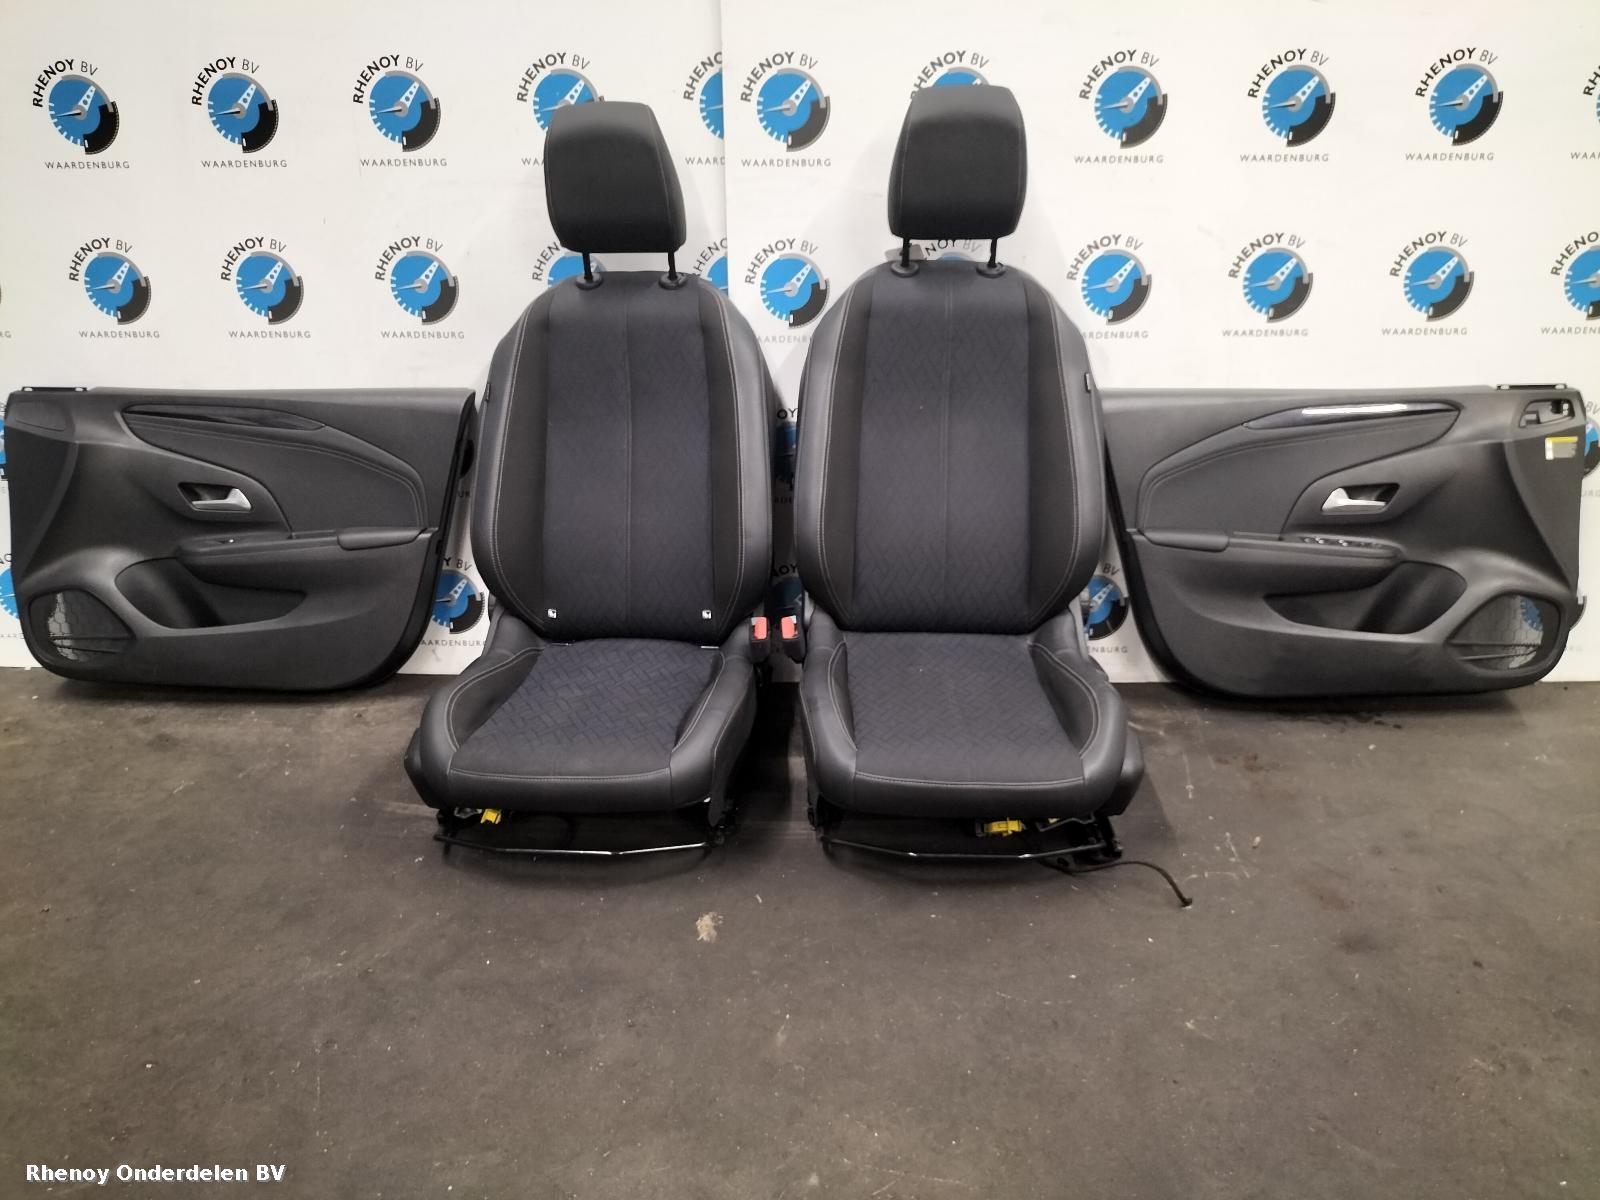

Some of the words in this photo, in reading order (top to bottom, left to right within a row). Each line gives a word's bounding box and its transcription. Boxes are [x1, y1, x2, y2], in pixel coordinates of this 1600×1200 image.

[353, 54, 400, 104] RHENOY
[405, 56, 424, 72] BV
[516, 52, 567, 103] RHENOY
[571, 54, 591, 71] BV
[683, 51, 722, 101] RHENO
[740, 51, 795, 102] RHENOY
[799, 53, 819, 70] BV
[970, 52, 990, 69] BV
[1079, 49, 1138, 100] RHENOY
[1140, 51, 1160, 68] BV
[1247, 48, 1308, 98] RHENOY
[1310, 50, 1330, 67] BV
[1415, 47, 1477, 97] RHENOY
[1479, 49, 1499, 65] BV
[32, 59, 74, 107] RHENOY
[80, 61, 98, 76] BV
[191, 57, 236, 106] RHENOY
[241, 59, 260, 74] BV
[44, 161, 130, 170] WAARDENBURG
[201, 159, 288, 169] WAARDENBURG
[360, 158, 448, 167] WAARDENBURG
[741, 158, 832, 168] WAARDENBURG
[1073, 155, 1165, 164] WAARDENBURG
[1239, 154, 1330, 163] WAARDENBURG
[1405, 152, 1495, 161] WAARDENBURG
[68, 237, 111, 282] RHENOY
[115, 239, 133, 254] BV
[220, 236, 265, 281] RHENOY
[269, 238, 287, 253] BV
[375, 235, 421, 281] RHENOY
[425, 238, 444, 253] BV
[531, 241, 561, 281] RHEN
[693, 237, 727, 272] HENO
[744, 238, 797, 285] RHENOY
[800, 240, 819, 255] BV
[1066, 234, 1122, 281] RHENOY
[1125, 236, 1144, 251] BV
[1228, 232, 1285, 279] RHENOY
[1287, 234, 1306, 250] BV
[1389, 231, 1447, 277] RHENOY
[1449, 232, 1468, 248] BV
[1550, 231, 1599, 276] RHENO
[78, 330, 161, 339] WAARDENBURG
[228, 330, 311, 339] WAARDENBURG
[380, 330, 465, 340] WAARDENBURG
[1222, 328, 1309, 338] WAARDENBURG
[1381, 327, 1468, 336] WAARDENBURG
[1540, 326, 1600, 335] WAARDEN
[456, 559, 472, 571] BV
[1102, 563, 1119, 576] BV
